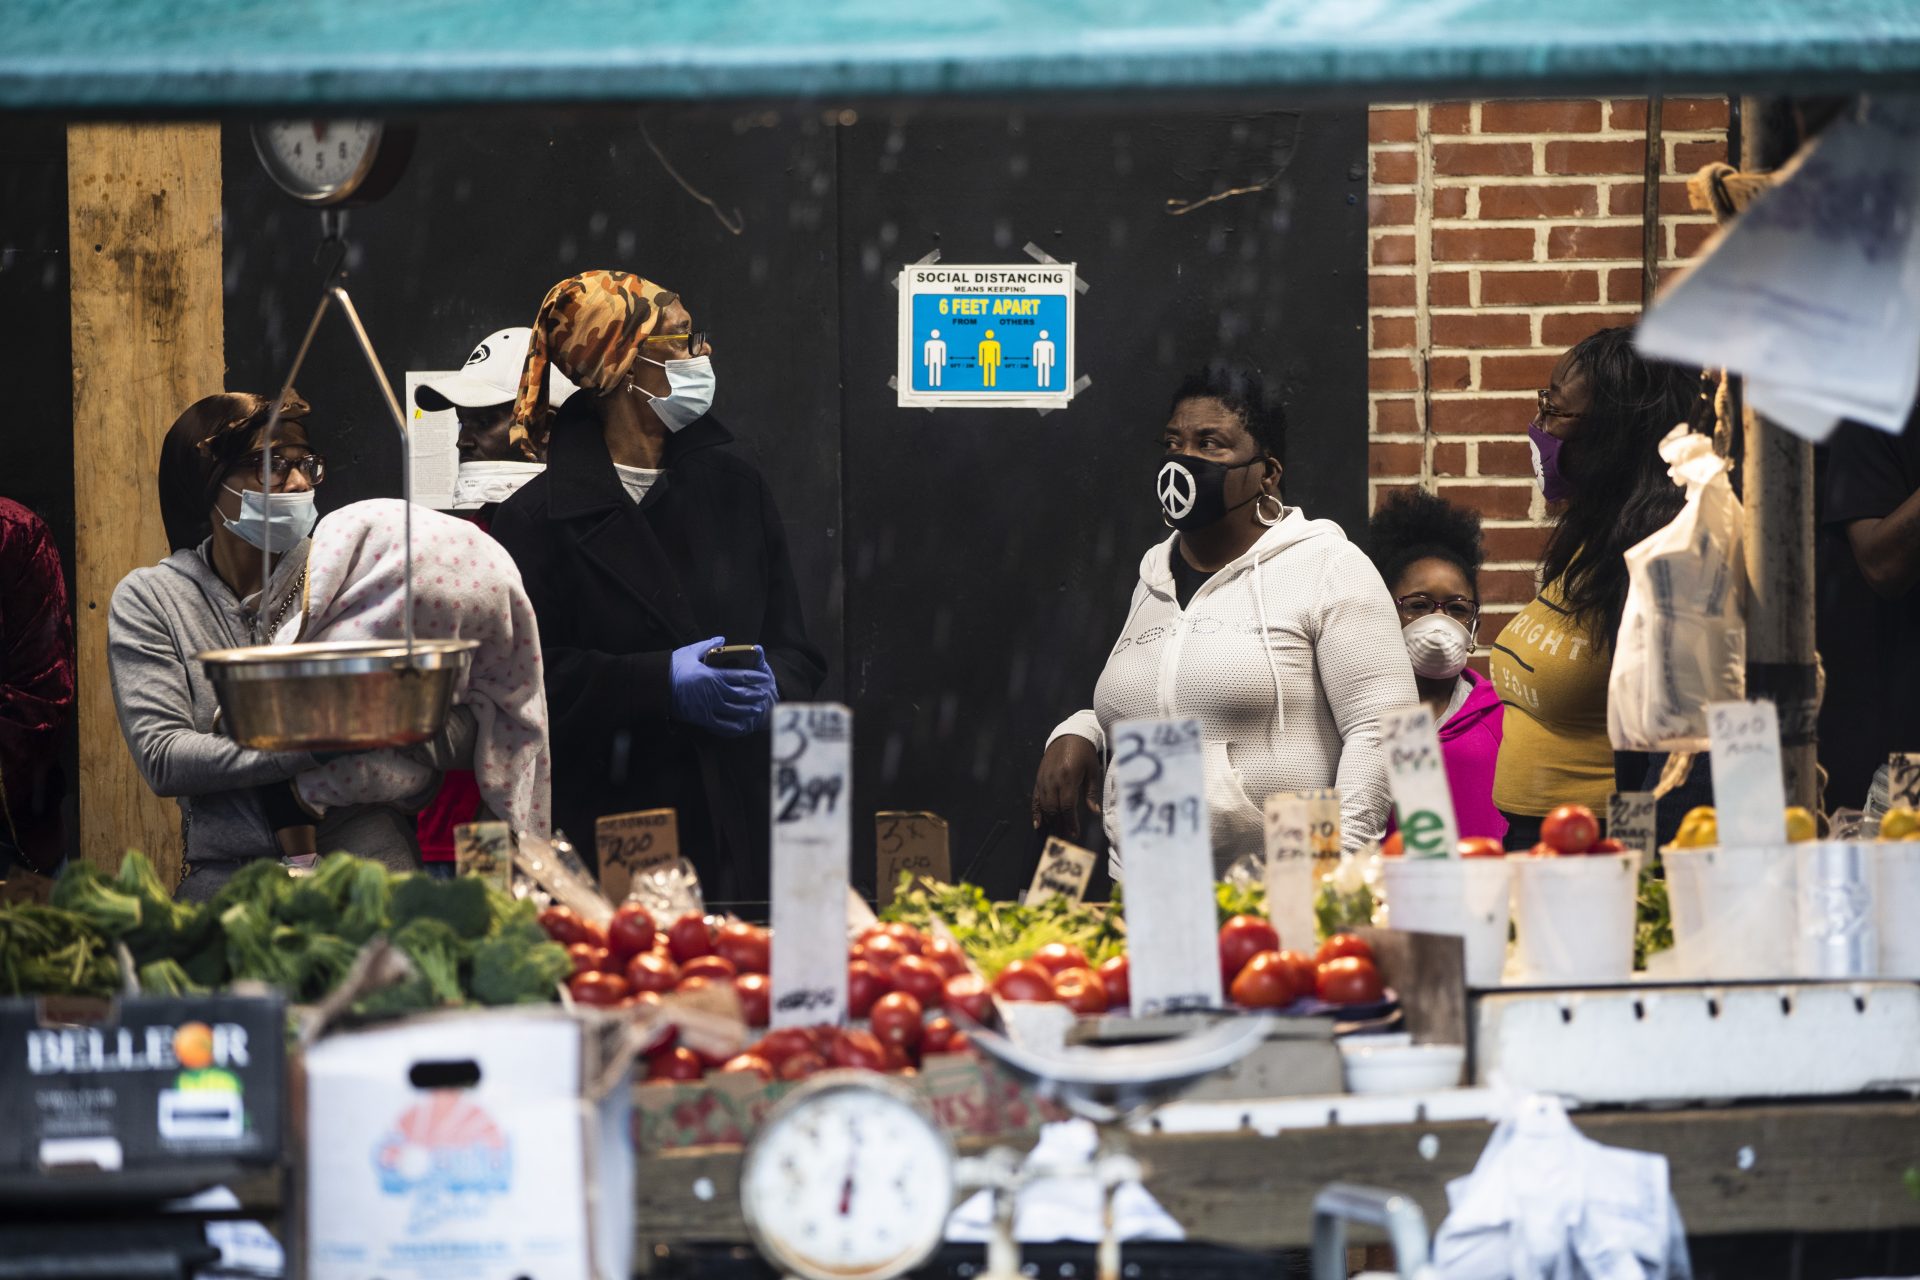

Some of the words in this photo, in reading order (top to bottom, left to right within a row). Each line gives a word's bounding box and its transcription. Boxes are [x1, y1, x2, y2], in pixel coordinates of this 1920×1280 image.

[917, 272, 969, 283] SOCIAL
[975, 273, 1063, 284] DISTANCING
[939, 298, 949, 315] 6
[952, 298, 989, 315] FEET
[992, 298, 1041, 315] APART
[999, 318, 1035, 326] OTHERS
[1503, 667, 1539, 708] YOU
[1117, 731, 1163, 788] 3
